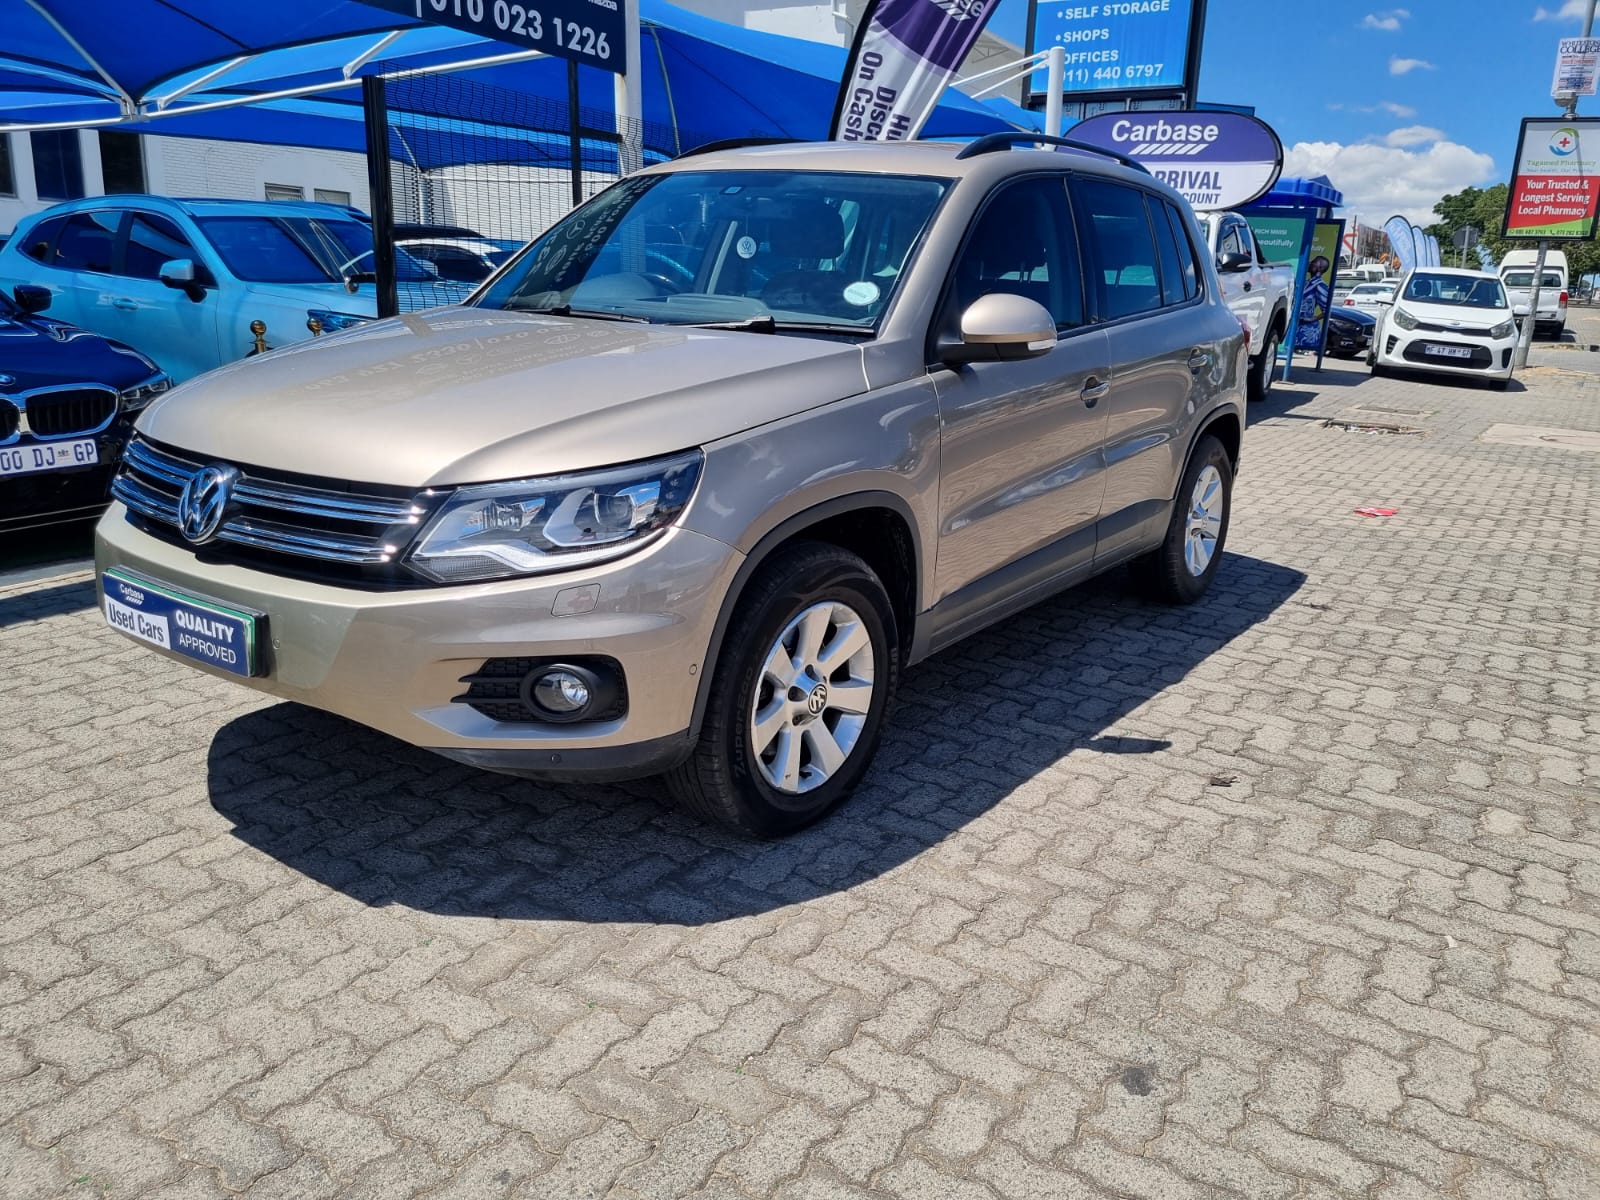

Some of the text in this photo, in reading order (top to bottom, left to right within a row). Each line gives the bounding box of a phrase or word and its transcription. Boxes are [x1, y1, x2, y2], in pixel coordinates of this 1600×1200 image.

[1065, 0, 1170, 20] SELF STORAGE
[494, 0, 543, 40] 023
[553, 17, 610, 60] 1226
[1063, 28, 1110, 43] SHOPS
[1063, 63, 1163, 84] 11) 440 6797
[844, 51, 883, 141] On Cash
[1111, 119, 1219, 142] Carbase
[1154, 170, 1222, 190] RRIVAL
[1527, 179, 1589, 190] Your Trusted &
[1520, 192, 1591, 204] Longest Serving
[1518, 205, 1587, 218] Local Pharmacy
[1258, 238, 1294, 248] eautifully
[32, 446, 55, 468] DJ
[74, 442, 94, 462] GP
[120, 583, 144, 601] Carbase
[108, 602, 165, 642] Used Cars
[175, 609, 234, 643] QUALITY
[179, 633, 236, 665] APPROVED
